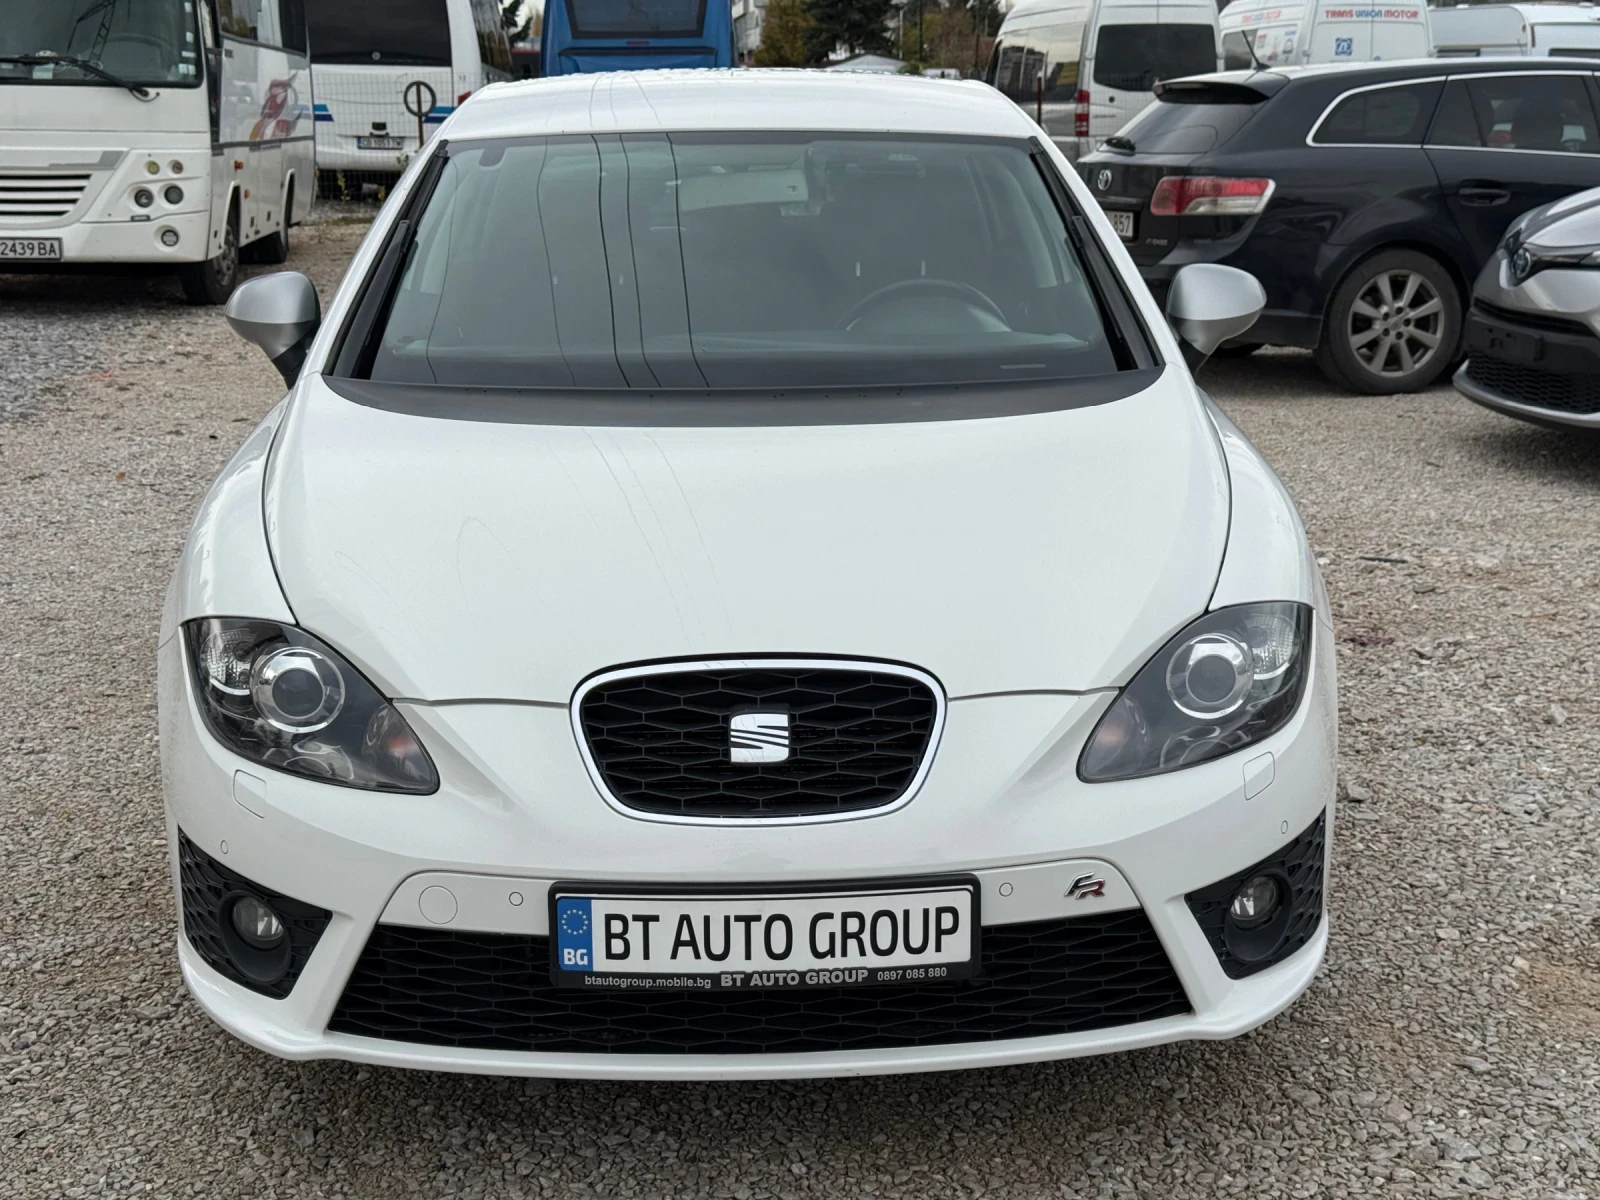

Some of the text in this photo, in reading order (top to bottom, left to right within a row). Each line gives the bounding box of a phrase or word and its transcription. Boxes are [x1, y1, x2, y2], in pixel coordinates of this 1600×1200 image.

[1383, 9, 1419, 19] MOTOR
[1113, 214, 1131, 234] 857
[0, 242, 57, 256] 2439 BA
[1064, 871, 1106, 900] FR
[604, 905, 960, 962] BT AUTO GROUP
[563, 948, 588, 966] BG
[584, 966, 948, 989] btautogroup.mobile.bg BT AUTO GROUP 0897 085 880
